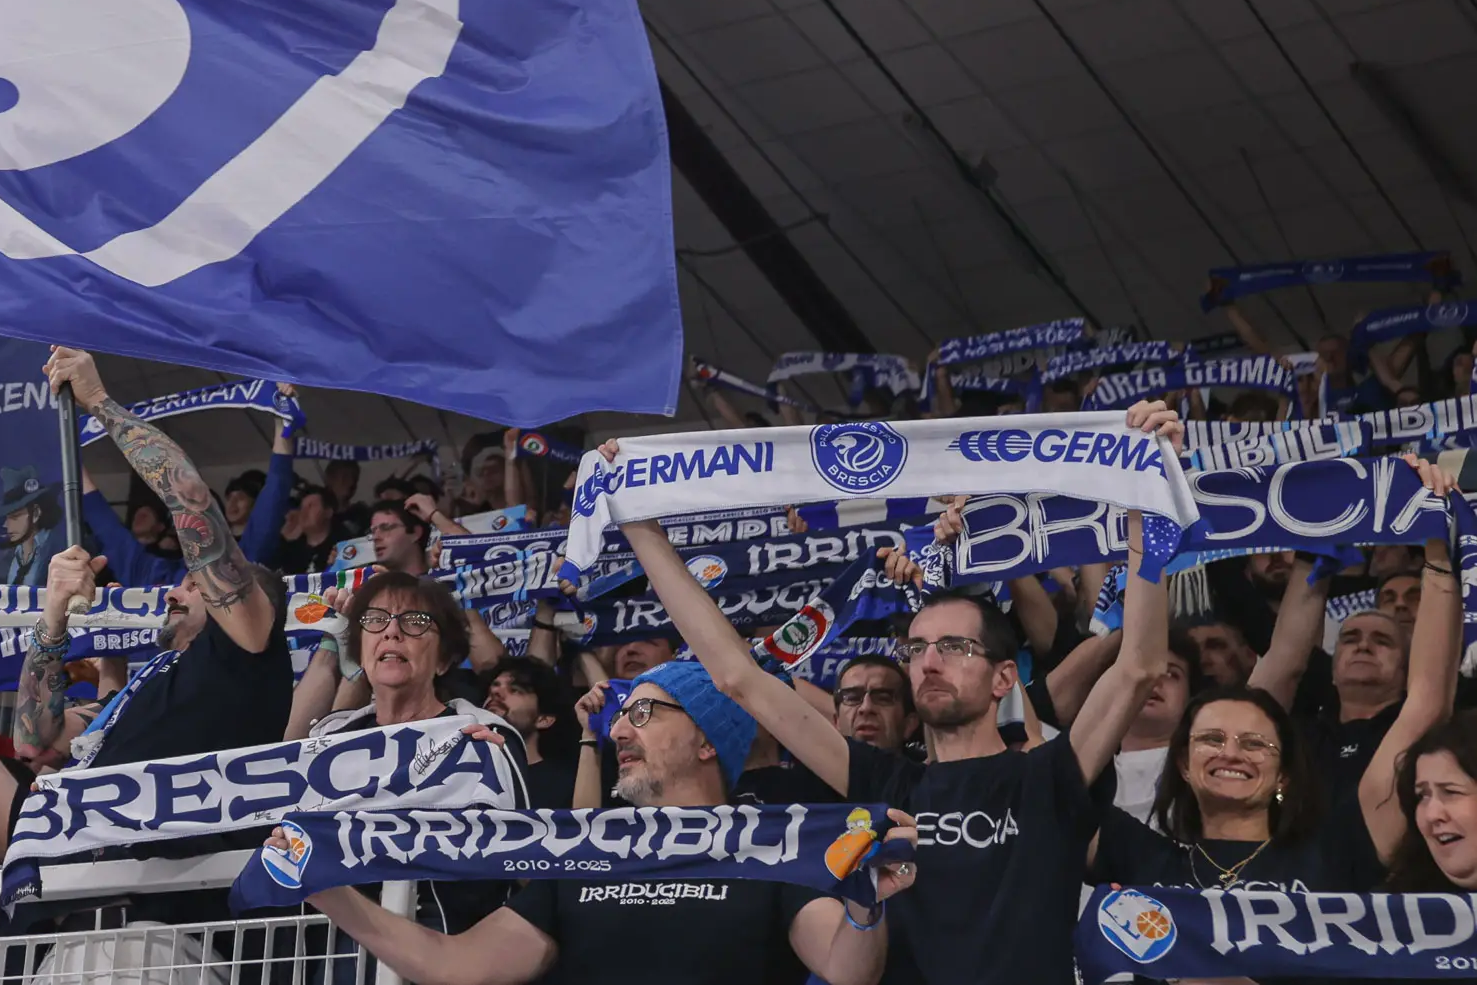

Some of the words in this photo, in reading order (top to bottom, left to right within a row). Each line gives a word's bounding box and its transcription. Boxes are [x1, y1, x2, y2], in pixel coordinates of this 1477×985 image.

[828, 464, 893, 486] BRESCIA
[10, 726, 506, 841] BRESCIA
[339, 803, 809, 867] IRRIDUCIBILI
[504, 859, 552, 872] 2010
[564, 859, 612, 872] 2025
[579, 882, 729, 903] IRRIDUCIBILI
